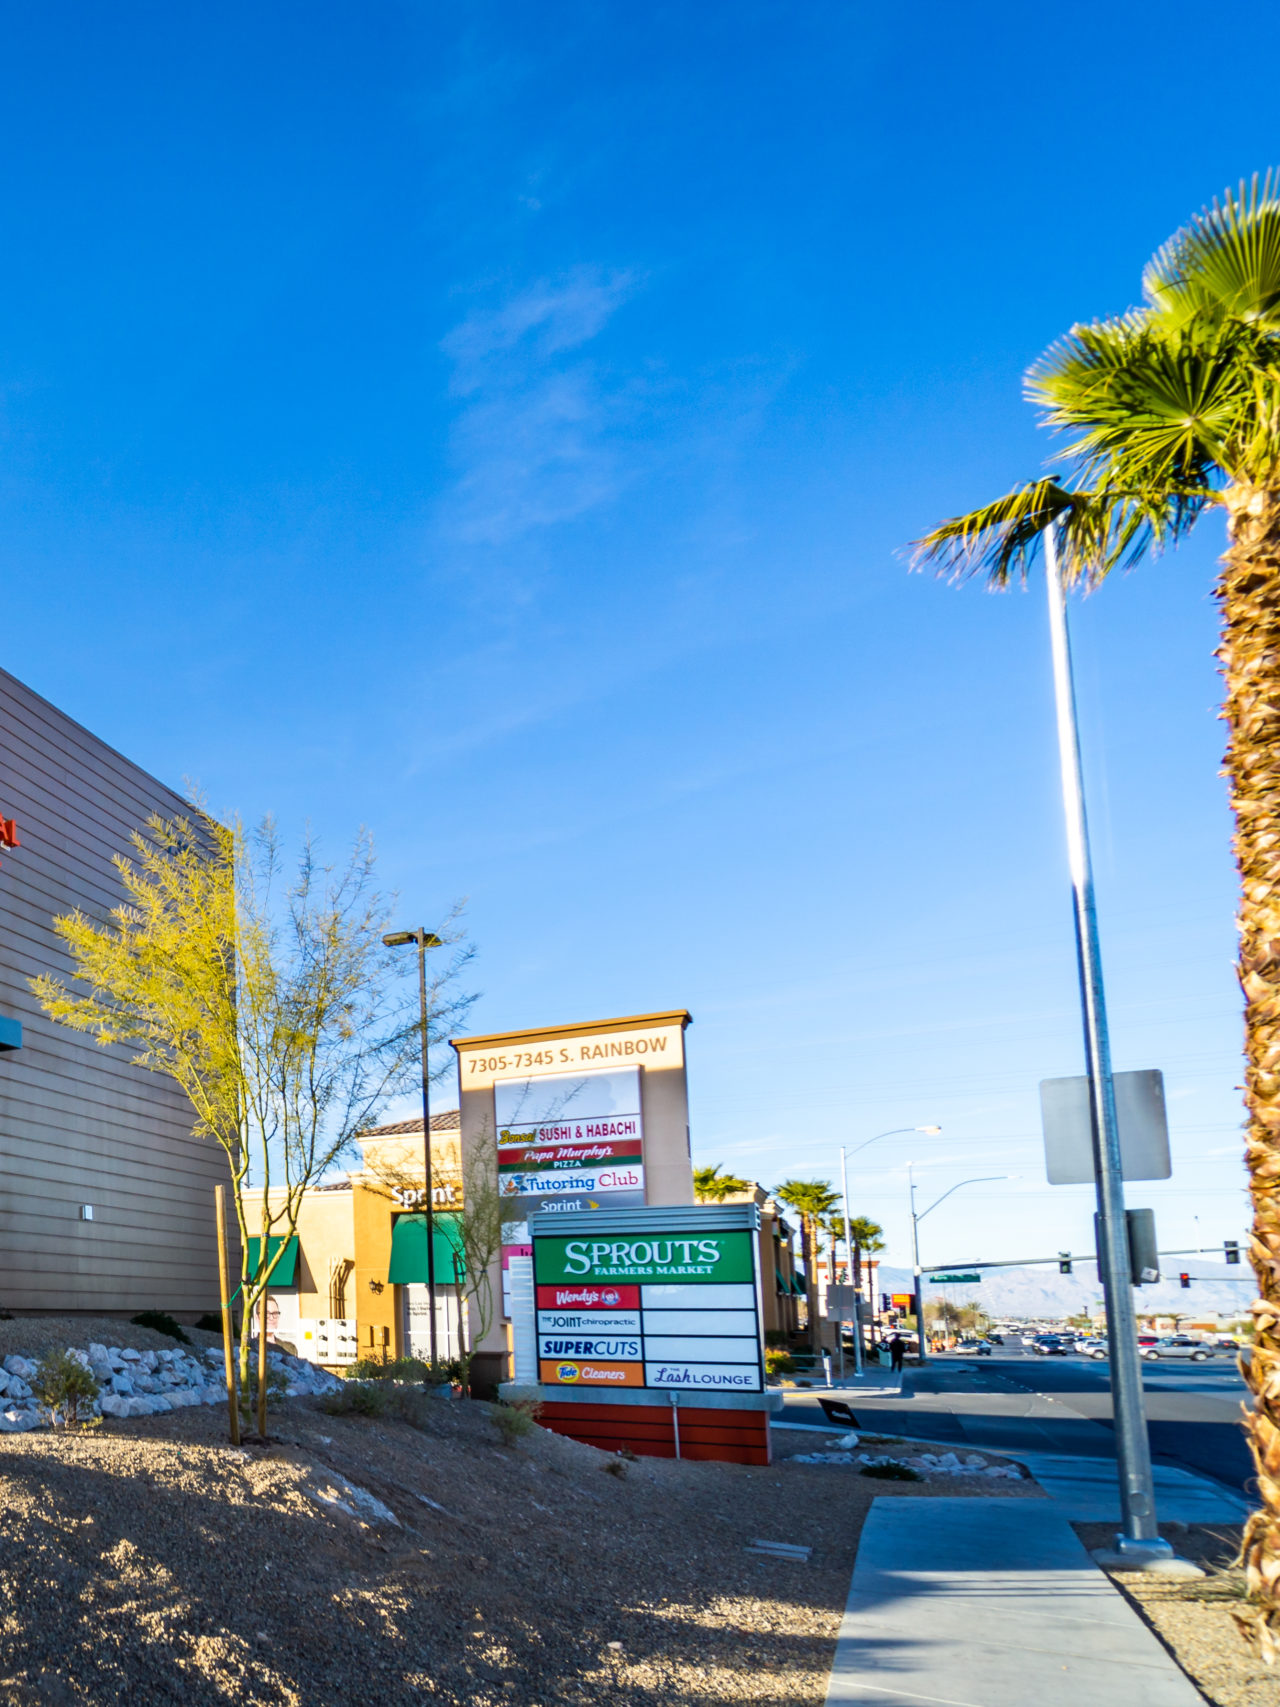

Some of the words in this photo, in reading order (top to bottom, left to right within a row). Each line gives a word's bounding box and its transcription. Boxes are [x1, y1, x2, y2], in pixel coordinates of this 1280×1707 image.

[468, 1050, 554, 1074] 7305-7345
[560, 1050, 575, 1063] S.
[580, 1036, 668, 1061] RAINBOW
[538, 1126, 572, 1142] SUSHI
[575, 1125, 583, 1138] &
[586, 1120, 637, 1138] HABACHI
[523, 1149, 553, 1163] Papa
[556, 1145, 614, 1161] Murphy's
[553, 1160, 582, 1169] PIZZA
[526, 1175, 596, 1192] Tutoring
[598, 1171, 639, 1187] Club
[391, 1183, 456, 1209] Sprnt
[540, 1198, 581, 1212] Sprint
[563, 1240, 721, 1275] SPROUTS
[594, 1266, 653, 1276] FARMERS
[656, 1265, 714, 1275] MARKET
[556, 1288, 599, 1306] Wendy's
[552, 1317, 581, 1328] JOINT
[582, 1317, 637, 1327] chiropractic
[543, 1340, 638, 1356] SUPERCUTS
[557, 1365, 578, 1377] Tide
[581, 1366, 626, 1381] Cleaners
[653, 1367, 692, 1384] Lash
[692, 1374, 753, 1386] LOUNGE
